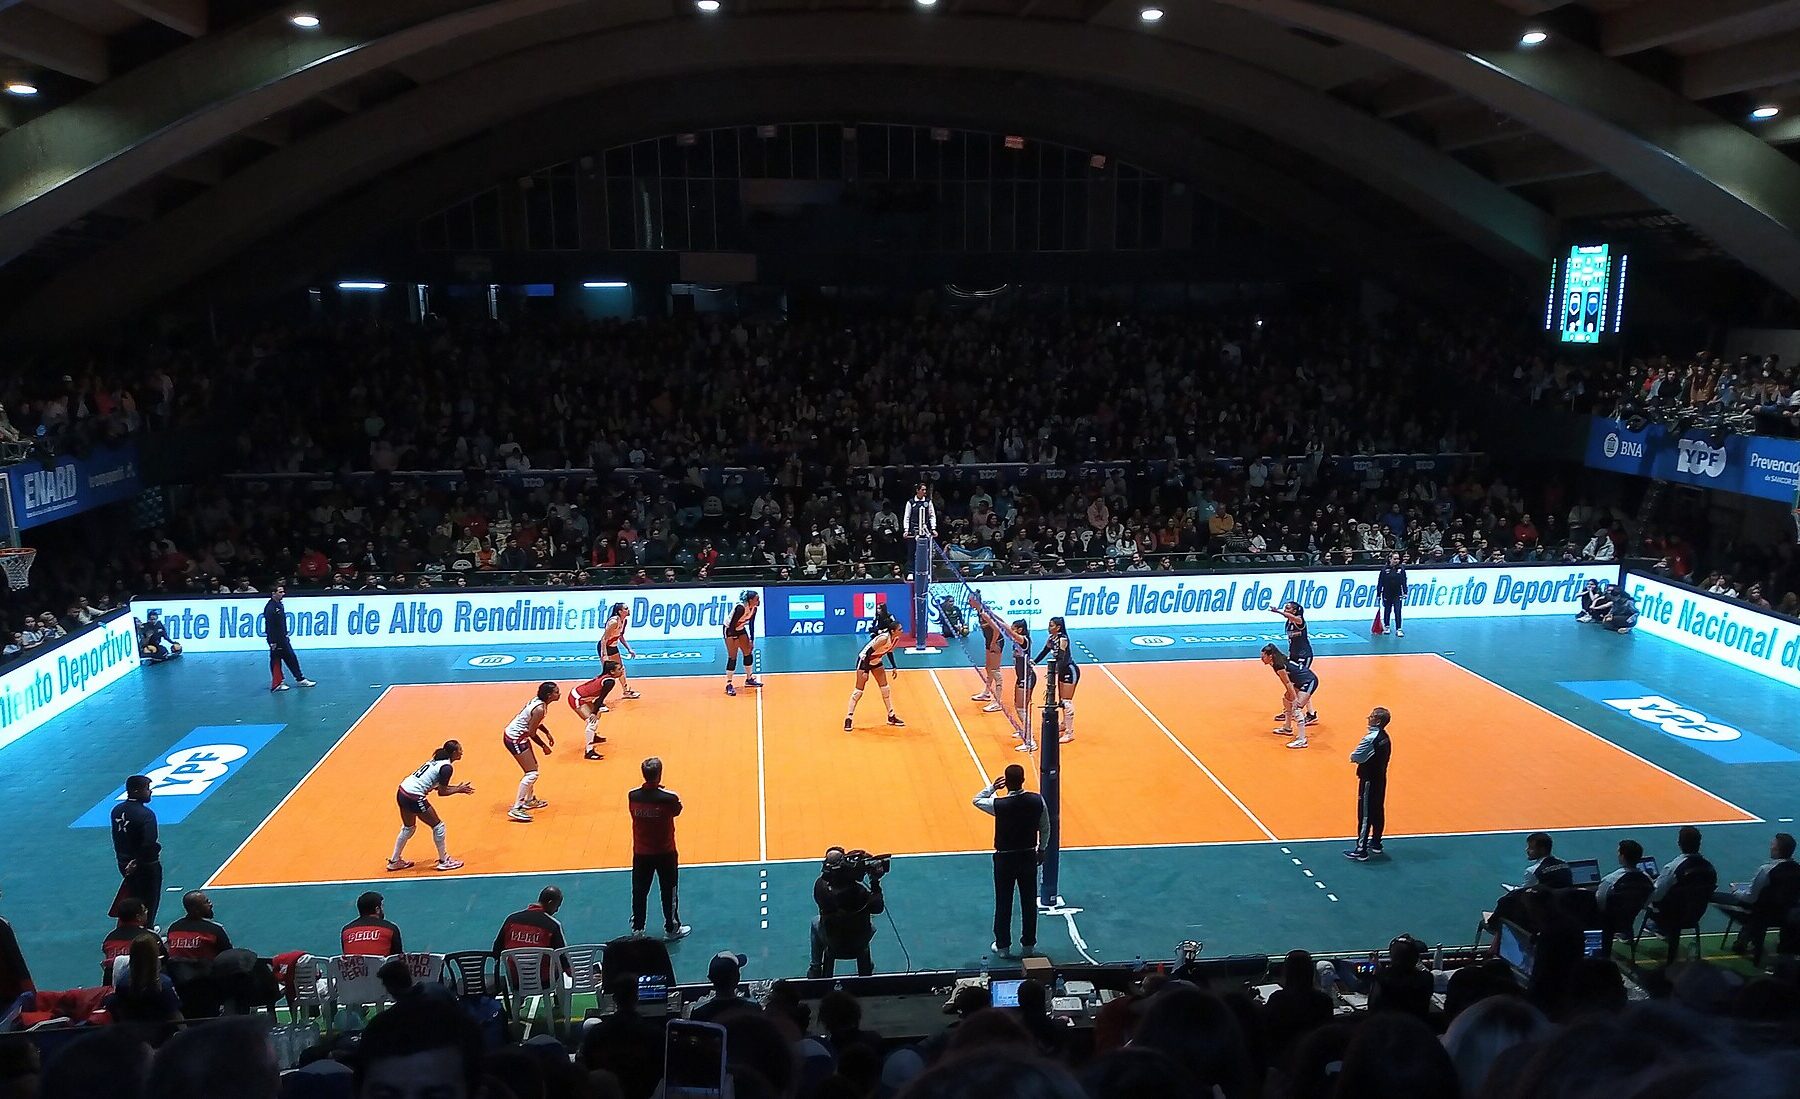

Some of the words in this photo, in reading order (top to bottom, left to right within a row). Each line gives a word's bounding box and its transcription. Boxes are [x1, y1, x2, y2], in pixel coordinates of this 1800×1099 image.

[1620, 441, 1643, 458] BNA
[24, 464, 77, 510] ENARD
[1065, 585, 1119, 616] Ente
[1127, 582, 1236, 615] Nacional
[1241, 580, 1273, 610] de
[1278, 579, 1328, 609] Alto
[1336, 576, 1487, 609] Renmiento
[147, 607, 209, 640] nte
[219, 603, 339, 639] Naconal
[347, 603, 380, 635] de
[388, 601, 443, 634] Alto
[791, 621, 825, 634] ARG
[855, 620, 879, 633] PE
[1676, 599, 1779, 661] Nacional
[1181, 634, 1257, 644] Banco
[58, 629, 132, 695] Deportivo
[524, 654, 600, 664] Banco
